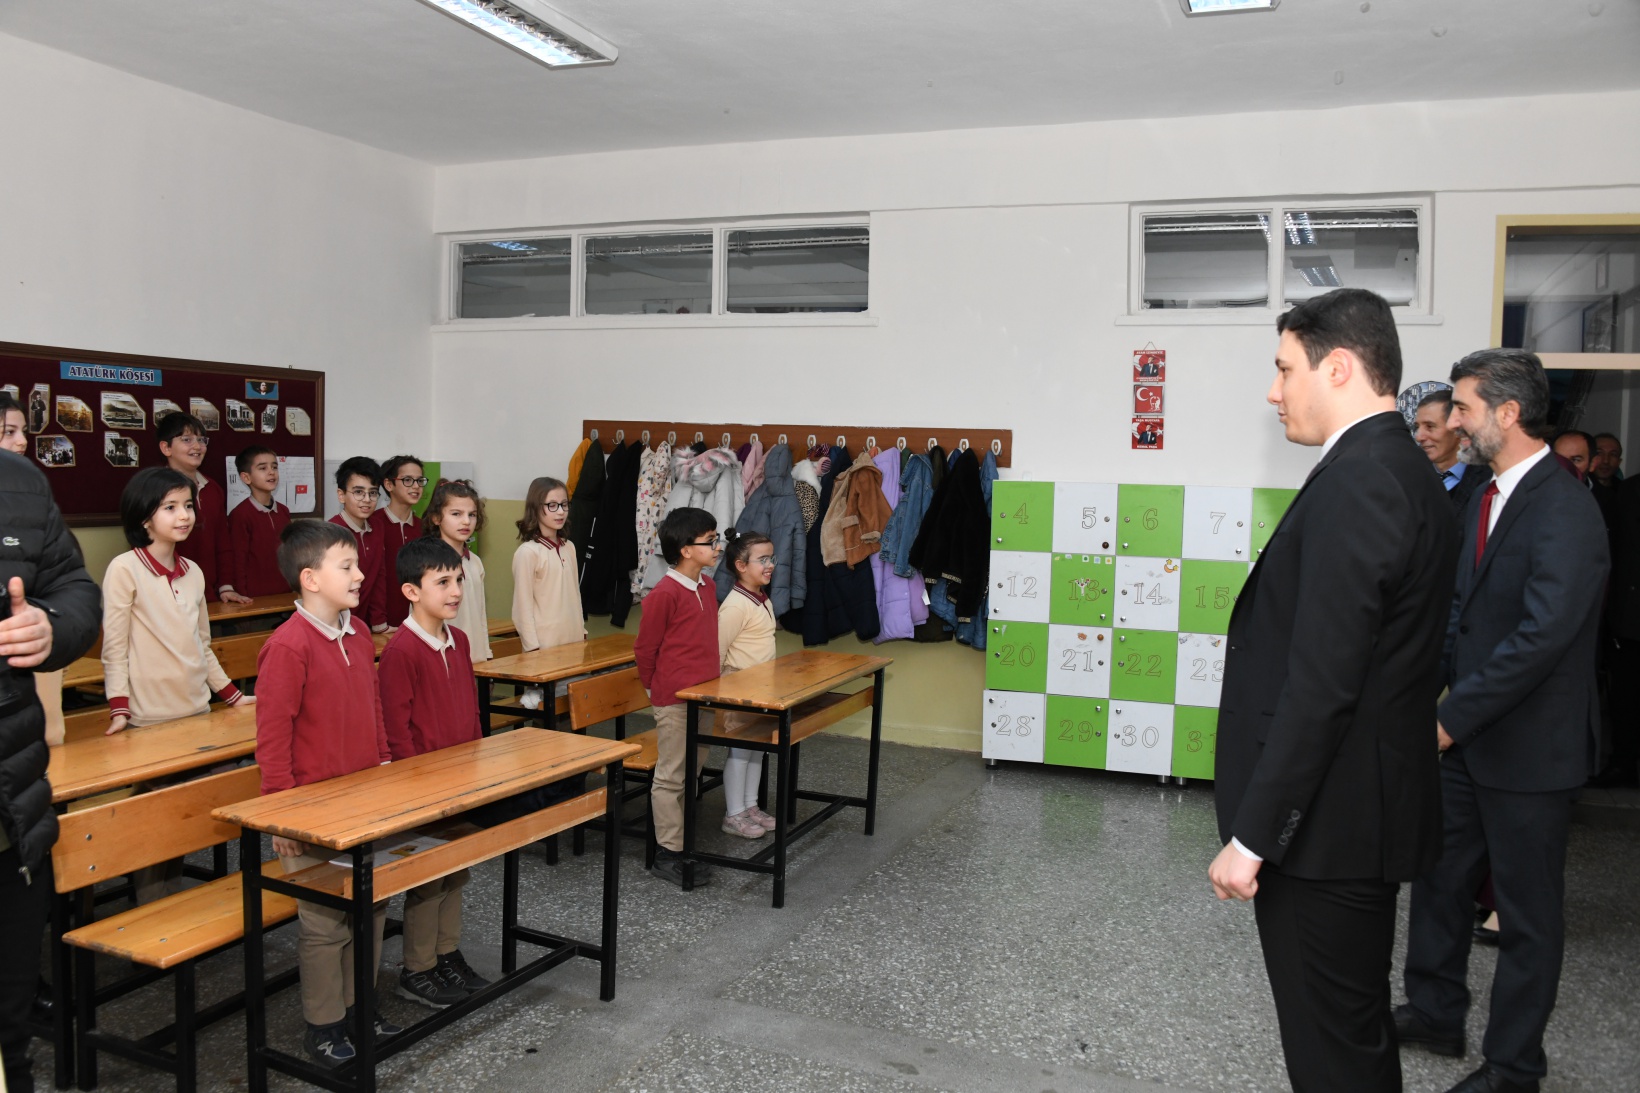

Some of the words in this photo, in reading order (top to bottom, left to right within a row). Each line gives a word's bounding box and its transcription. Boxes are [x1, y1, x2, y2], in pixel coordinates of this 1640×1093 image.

[69, 365, 117, 380] ATATÜRK
[119, 368, 155, 384] KÖŞESİ
[1013, 503, 1029, 524] 4
[1082, 507, 1096, 529] 5
[1142, 508, 1158, 530] 6
[1210, 512, 1226, 534] 7
[1007, 576, 1037, 598] 12
[1069, 579, 1100, 601] 13
[1134, 582, 1162, 605] 14
[1196, 586, 1229, 609] 15
[1000, 644, 1035, 667] 20
[1060, 649, 1093, 672] 21
[1126, 653, 1161, 677] 22
[1190, 658, 1224, 682] 23
[996, 714, 1031, 736] 28
[1058, 720, 1093, 742] 29
[1122, 725, 1159, 748] 30
